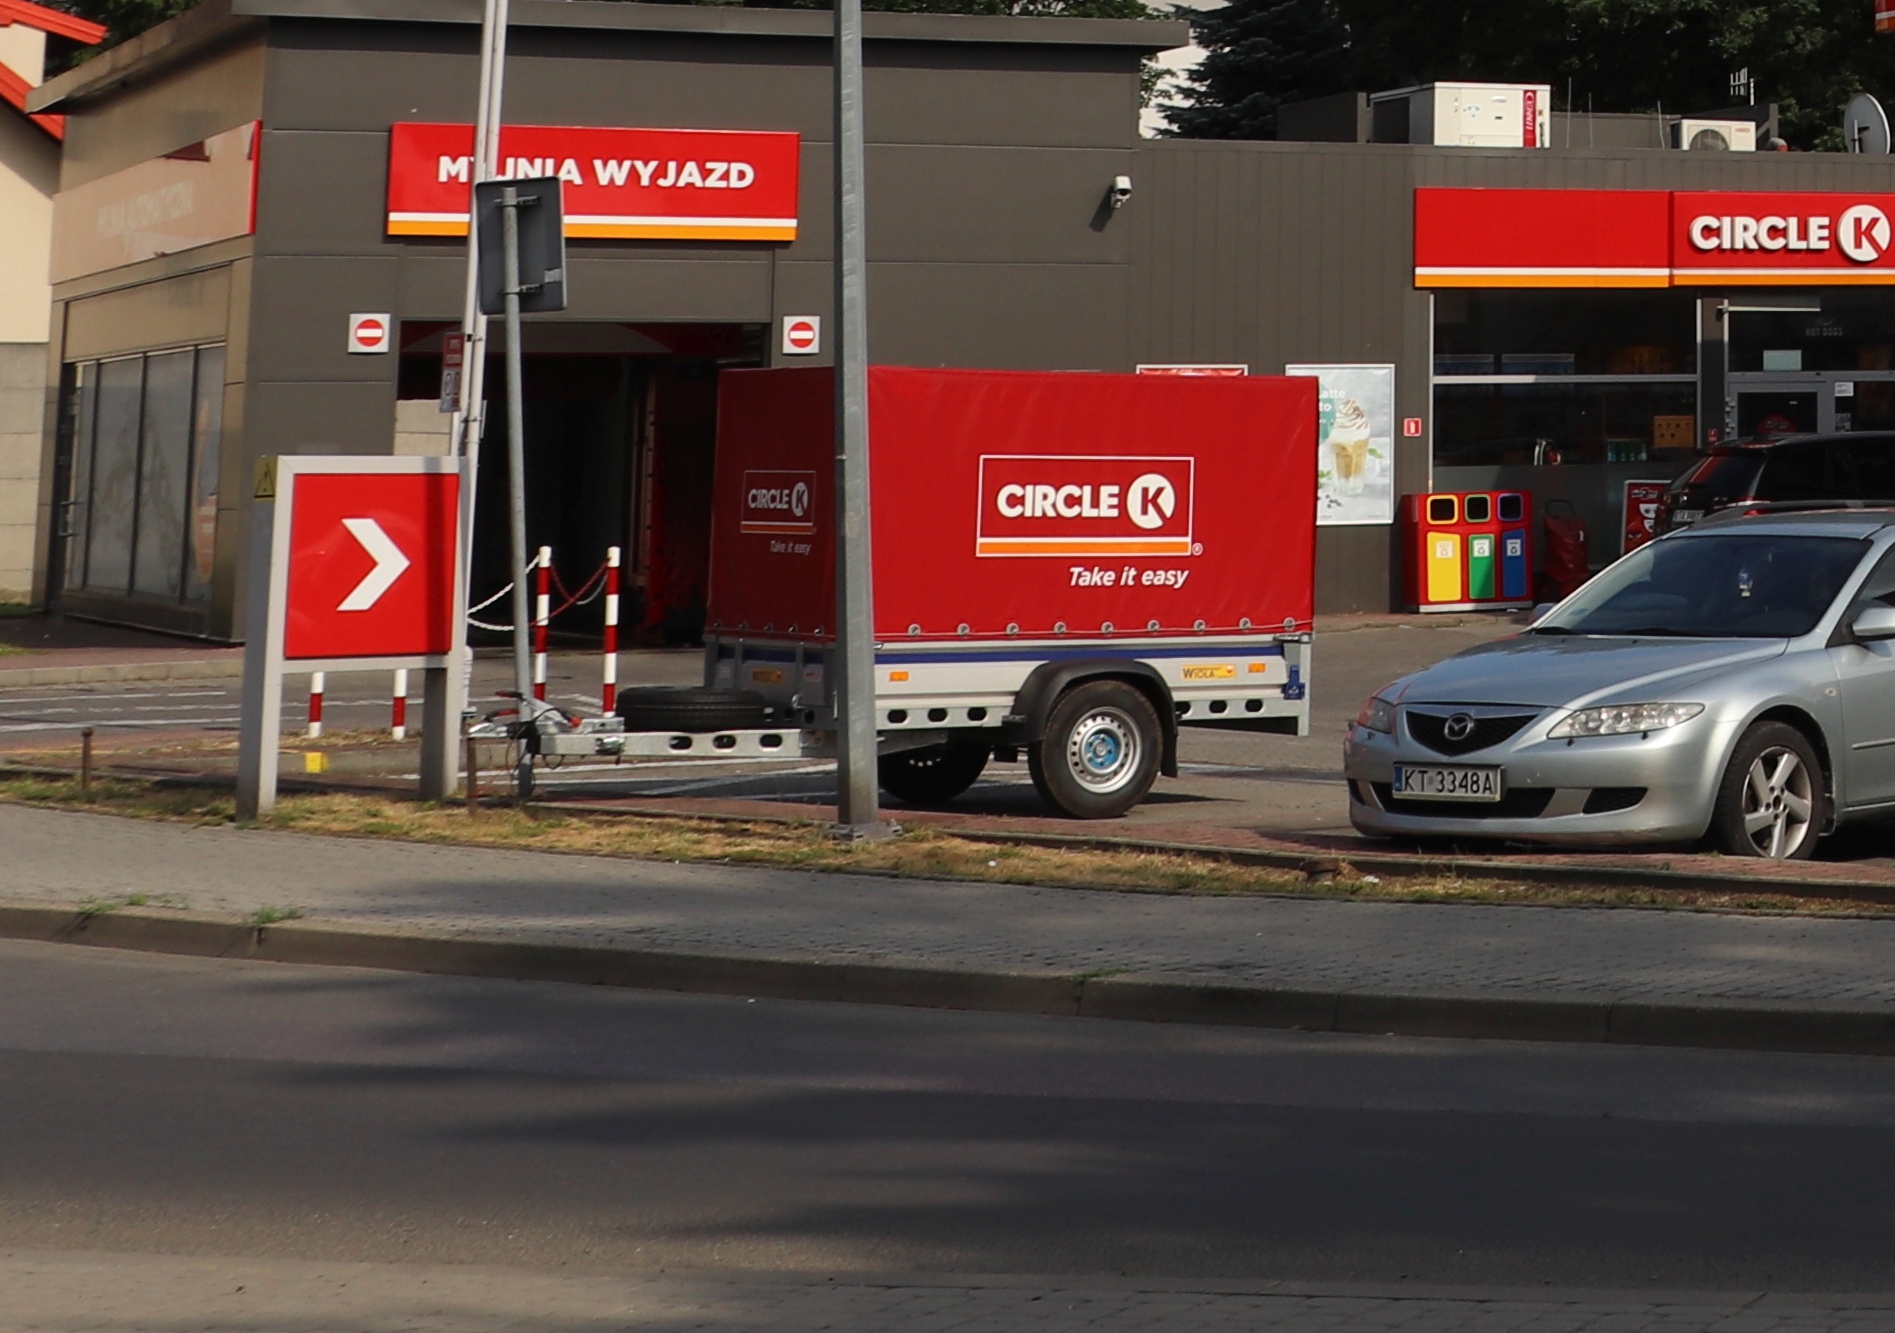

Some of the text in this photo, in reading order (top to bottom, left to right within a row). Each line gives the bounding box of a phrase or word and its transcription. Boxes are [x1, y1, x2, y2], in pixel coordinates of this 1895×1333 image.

[438, 155, 755, 189] MJNIA WYJAZD
[1690, 215, 1830, 251] CIRCLE
[1319, 388, 1346, 399] atte
[748, 488, 789, 510] CIRCLE
[997, 484, 1120, 518] CIRCLE
[769, 540, 812, 556] Take it easy
[1069, 565, 1190, 589] Take it easy
[1403, 769, 1494, 794] KT 3348A
